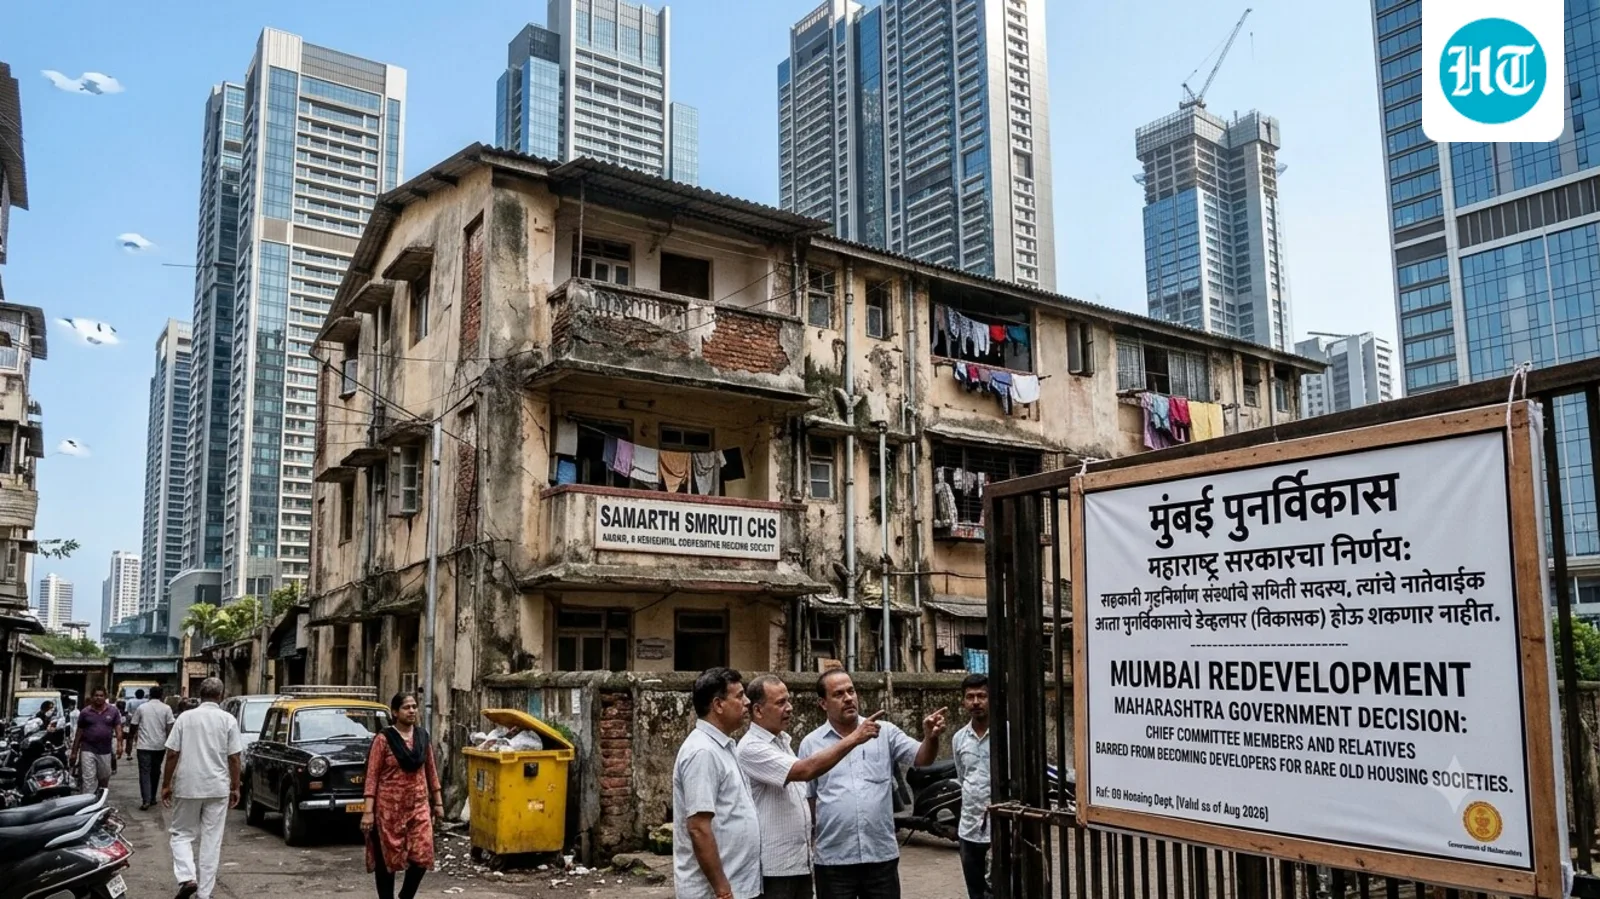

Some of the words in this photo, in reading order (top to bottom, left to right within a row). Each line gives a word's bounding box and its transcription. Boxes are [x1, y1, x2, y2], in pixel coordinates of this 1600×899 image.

[600, 504, 680, 532] SAMARTH
[685, 511, 742, 536] SMRUTI
[747, 517, 777, 539] CHS
[1149, 484, 1214, 549] मुंबई
[1222, 469, 1400, 542] पुनर्विकास
[1148, 552, 1219, 581] महाराष्ट्र
[1224, 543, 1325, 573] सरकारचा
[1356, 571, 1396, 596] त्यांचे
[1400, 566, 1486, 595] नातेवाईक
[1195, 608, 1248, 631] डेव्हलपर
[1251, 606, 1326, 631] (विकासक)
[1329, 603, 1364, 629] होऊ
[1367, 606, 1434, 625] शकणार
[1438, 597, 1500, 626] नाहीत.
[1111, 660, 1200, 690] MUMBAI
[1209, 660, 1471, 698] REDEVELOPMENT
[1114, 696, 1225, 720] MAHARASHTRA
[1228, 702, 1352, 727] GOVERNMENT
[1358, 706, 1467, 734] DECISION:
[1146, 725, 1175, 741] CHIEF
[1177, 727, 1240, 747] COMMITTEE
[1243, 731, 1304, 751] MEMBERS
[1307, 735, 1335, 753] AND
[1338, 738, 1416, 760] RELATIVES
[1096, 741, 1129, 757] BARRED
[1130, 744, 1156, 760] FROM
[1157, 747, 1207, 765] BECOMING
[1209, 752, 1277, 772] DEVELOPERS
[1279, 758, 1302, 773] FOR
[1339, 763, 1364, 779] OLD
[1367, 765, 1428, 786] HOUSING
[1432, 770, 1514, 794] SOCIETIES.
[1212, 801, 1222, 814] of
[1224, 804, 1241, 819] Aug
